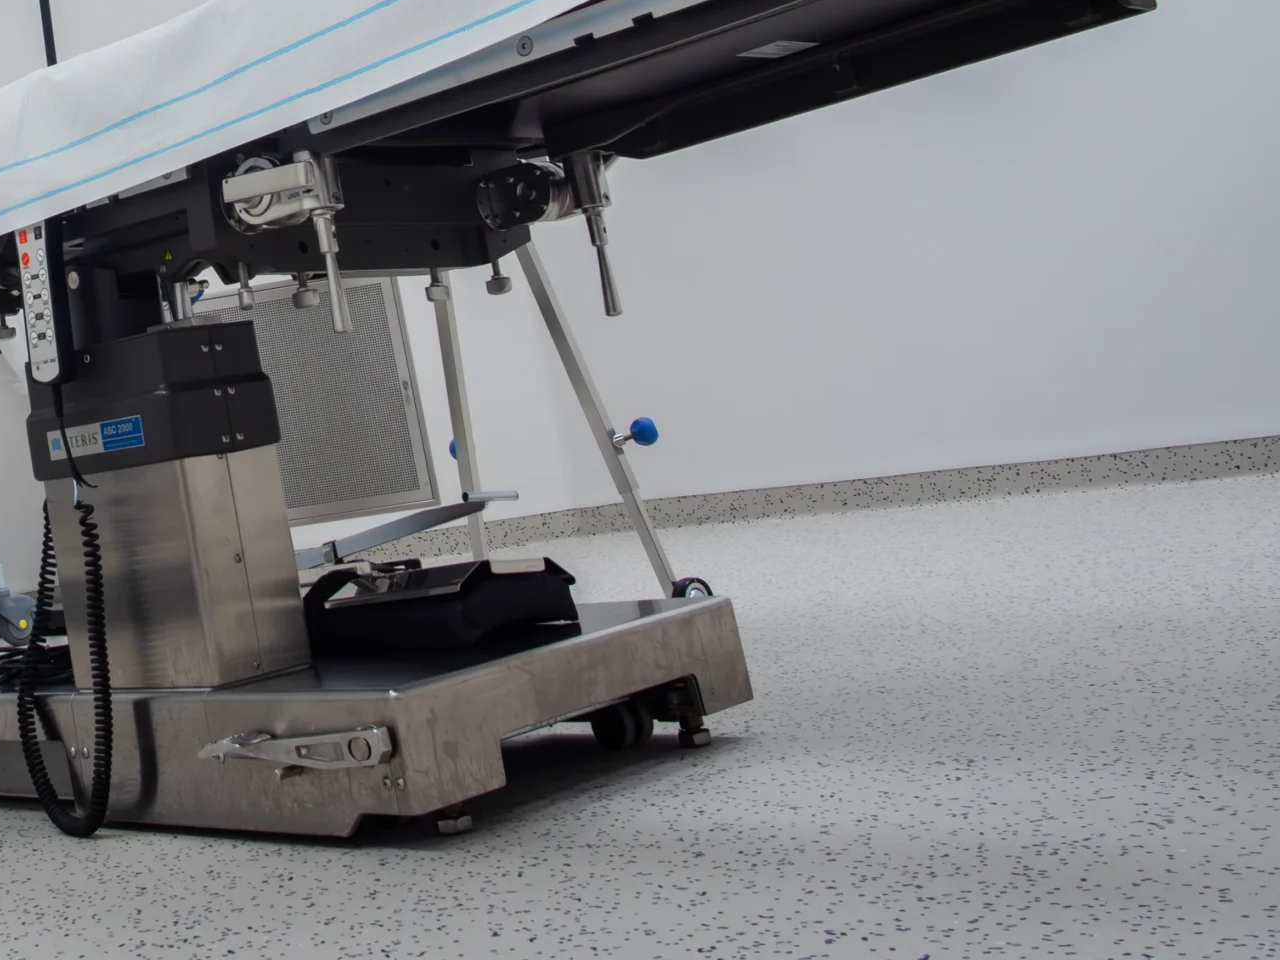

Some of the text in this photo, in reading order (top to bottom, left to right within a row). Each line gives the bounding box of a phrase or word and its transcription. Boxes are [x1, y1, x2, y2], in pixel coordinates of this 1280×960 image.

[287, 191, 300, 200] LOCK
[103, 422, 134, 436] ASC 2000
[67, 432, 99, 449] TERIS
